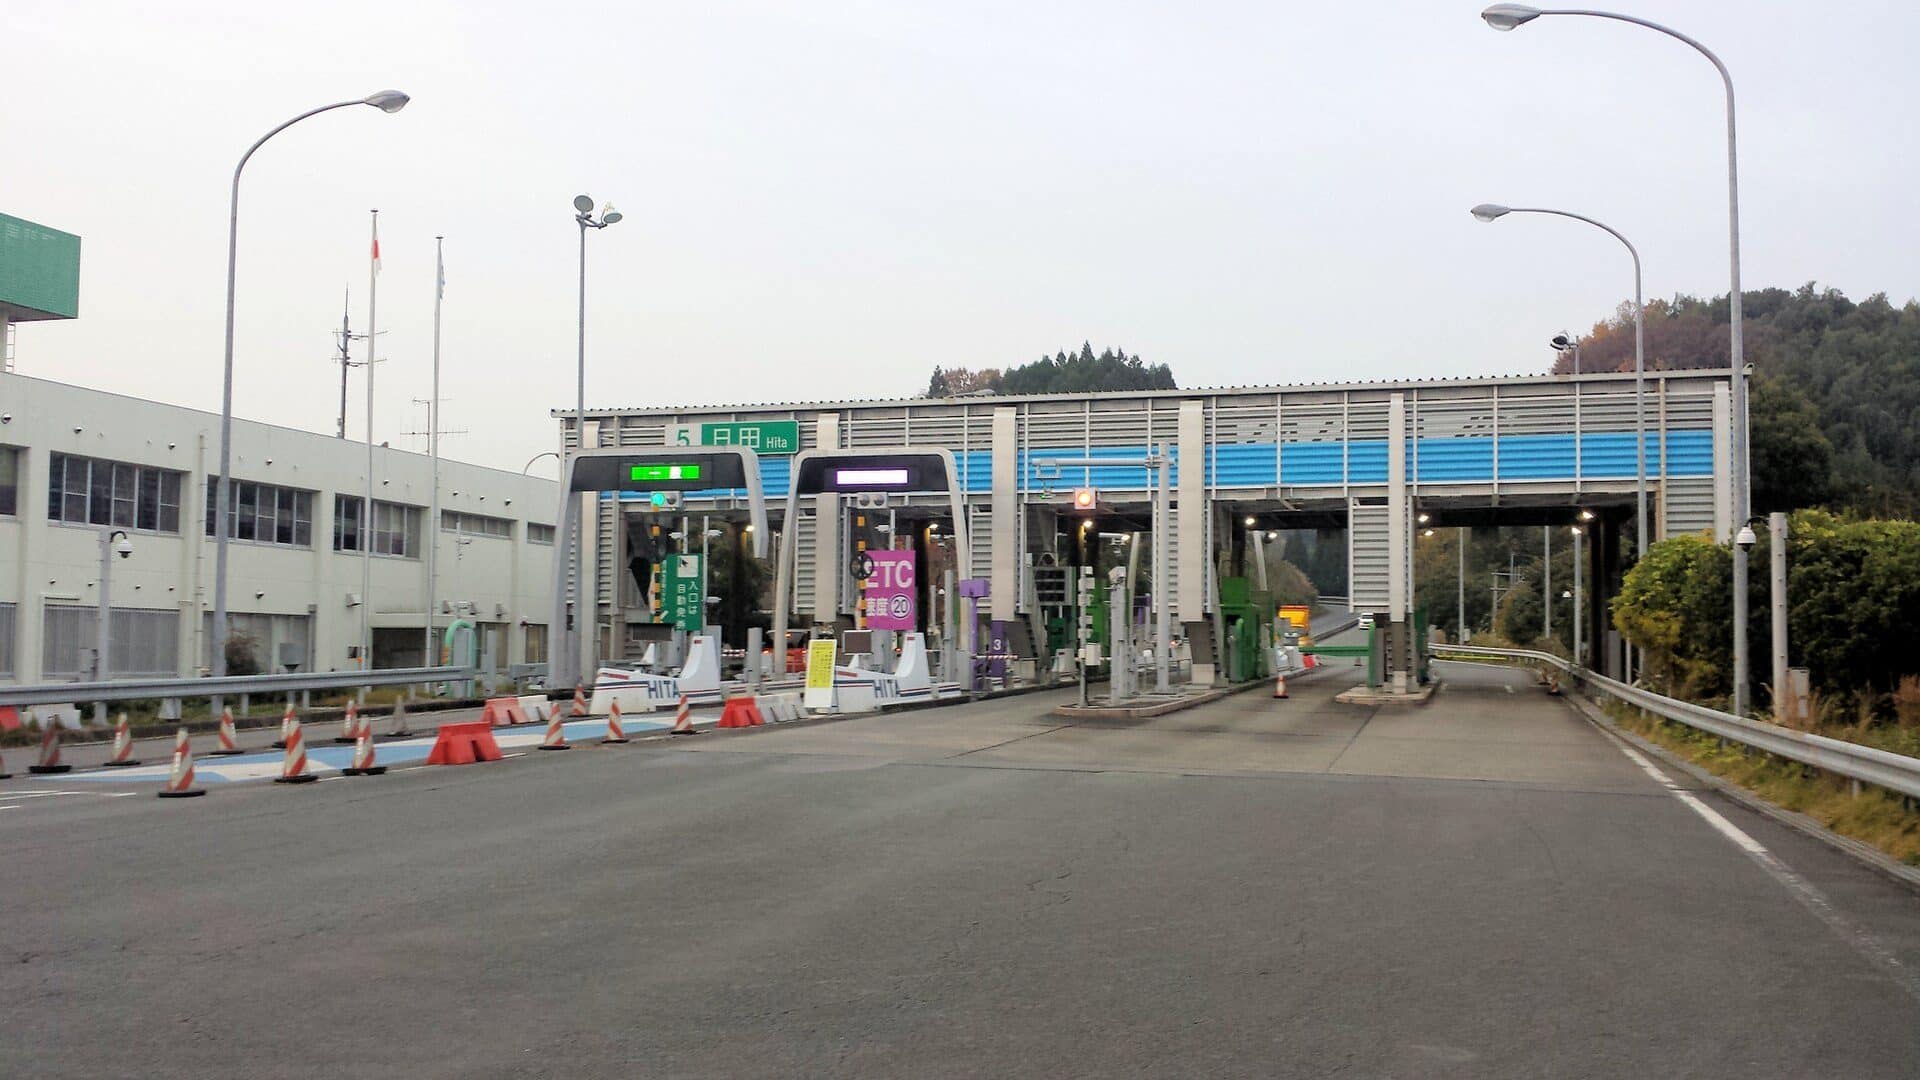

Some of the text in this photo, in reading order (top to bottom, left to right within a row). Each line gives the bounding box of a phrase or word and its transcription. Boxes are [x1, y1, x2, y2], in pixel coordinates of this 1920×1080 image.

[676, 429, 690, 446] 5
[713, 427, 761, 449] 日田
[766, 436, 788, 449] Hita
[864, 560, 913, 588] ETC
[687, 581, 698, 615] 入口は
[865, 597, 907, 616] 速度 20
[993, 639, 1002, 651] 3
[647, 679, 681, 699] HITA
